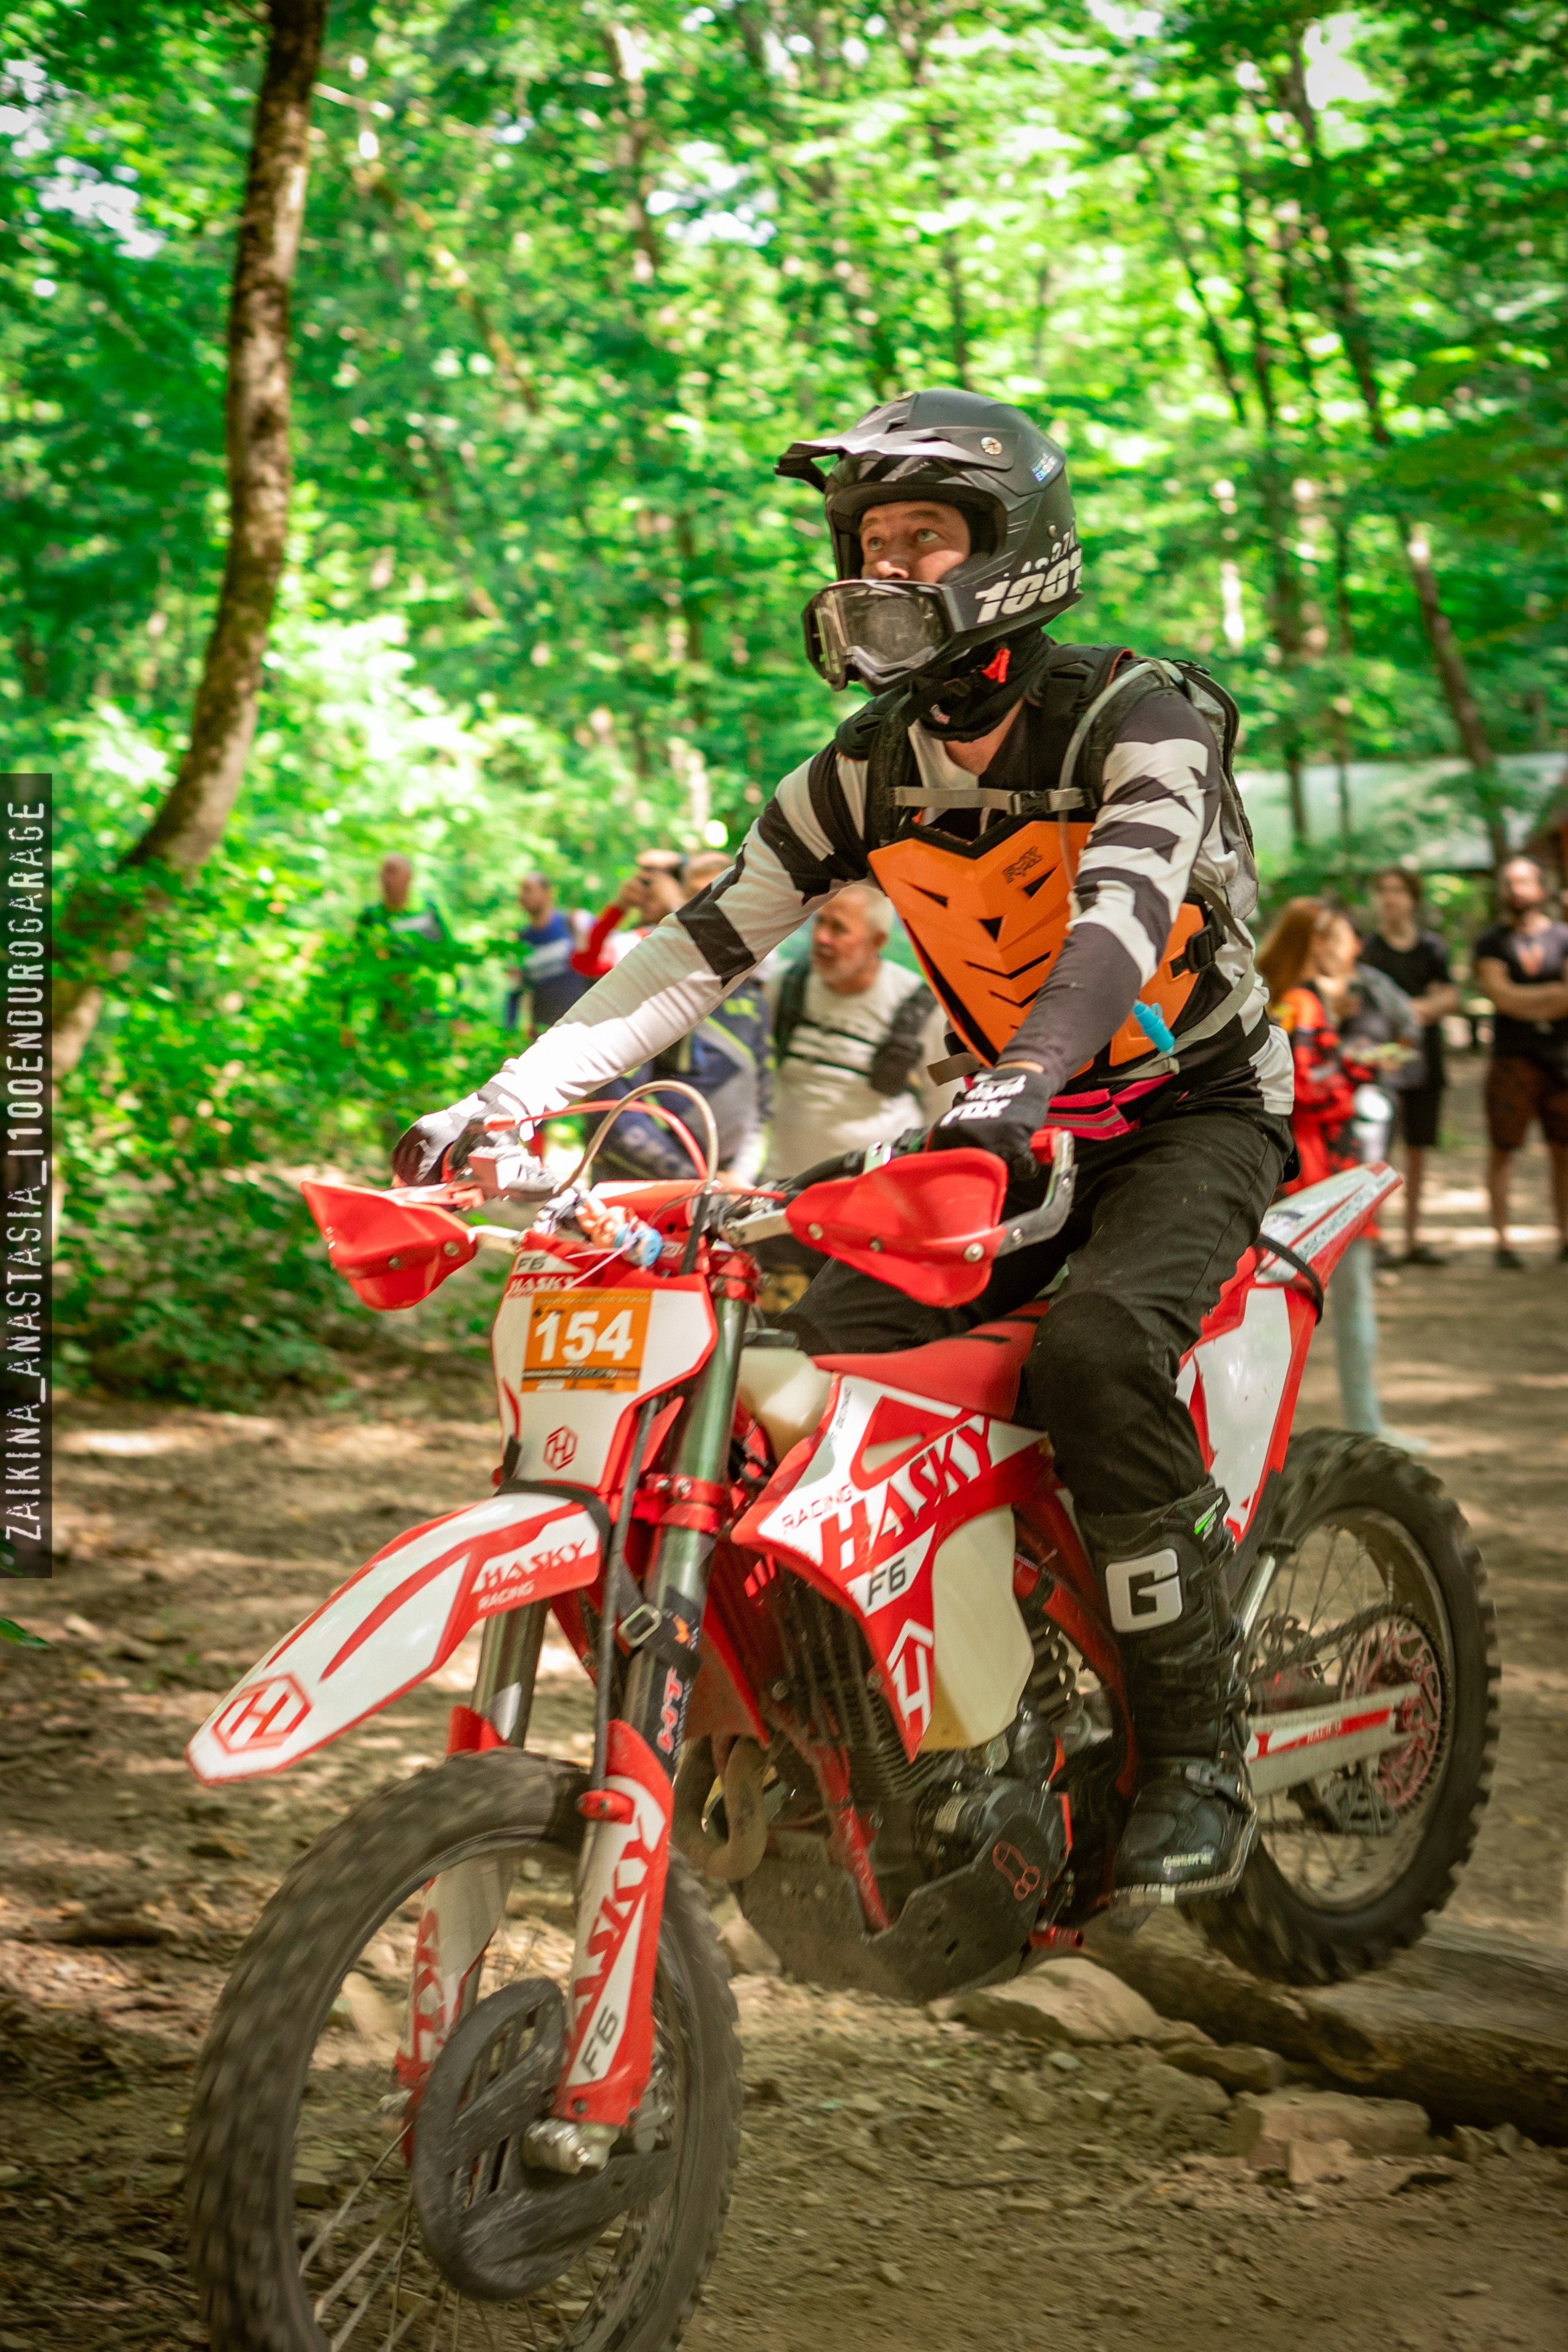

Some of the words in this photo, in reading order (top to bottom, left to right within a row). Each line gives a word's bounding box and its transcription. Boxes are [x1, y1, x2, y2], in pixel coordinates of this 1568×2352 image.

[1001, 846, 1043, 883] FOX
[939, 1099, 1012, 1127] FOX
[516, 1256, 546, 1272] F6
[534, 1308, 635, 1362] 154
[782, 1482, 852, 1533] RACING
[818, 1414, 992, 1574] HASKY
[483, 1538, 587, 1591] HASKY
[867, 1557, 908, 1607] F6
[478, 1579, 535, 1612] RACING
[1105, 1548, 1183, 1633] G
[581, 2005, 619, 2078] F6
